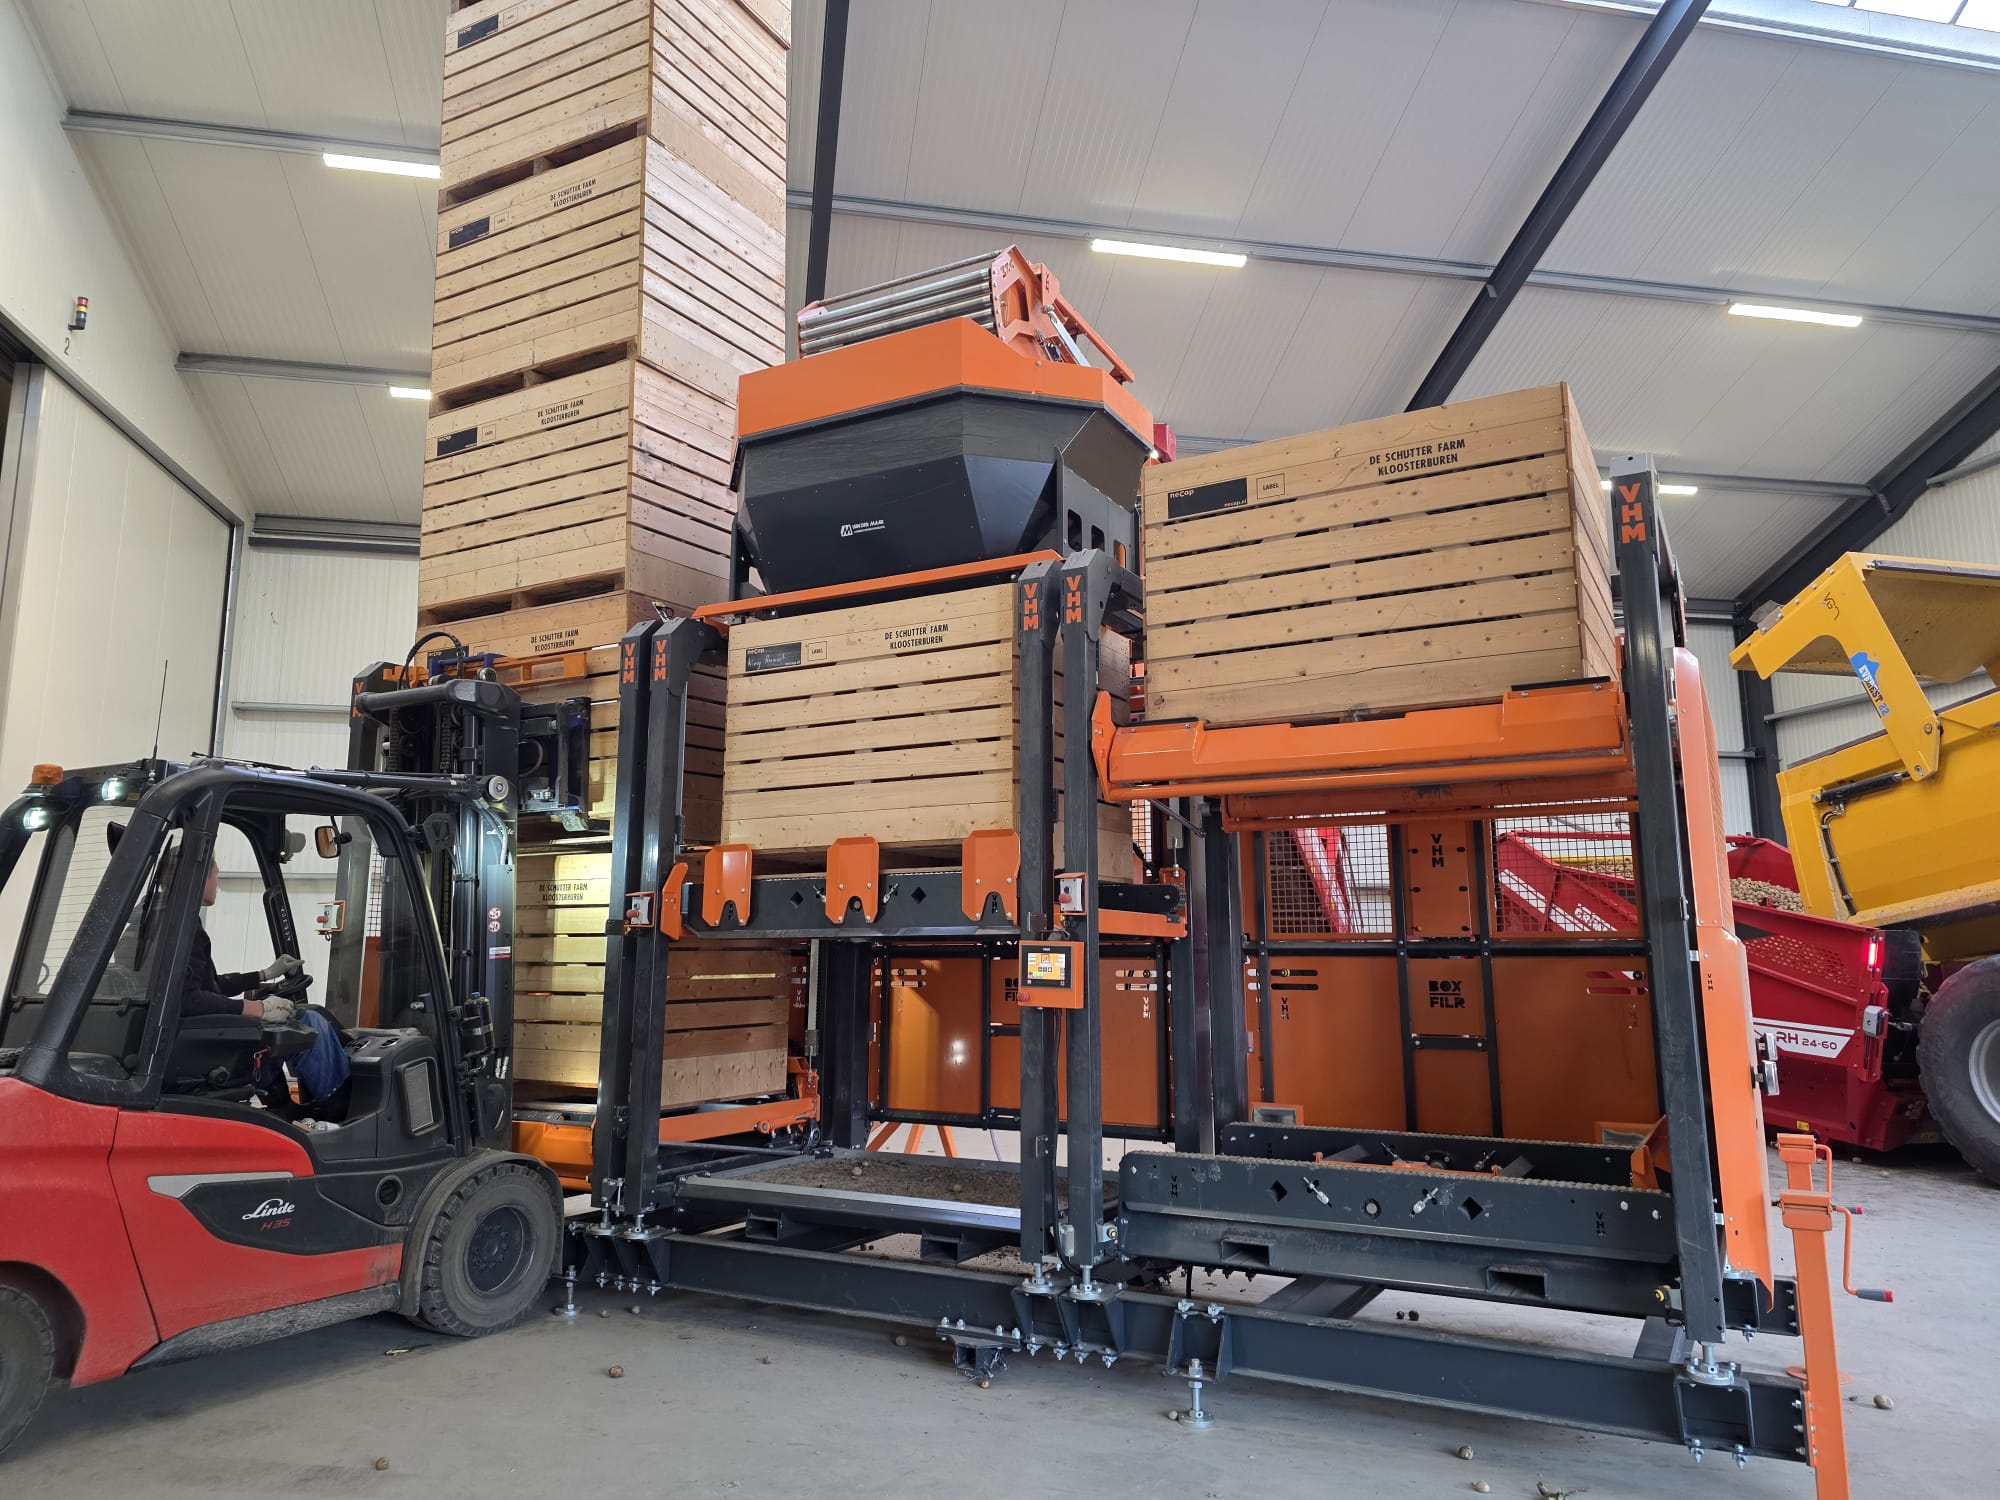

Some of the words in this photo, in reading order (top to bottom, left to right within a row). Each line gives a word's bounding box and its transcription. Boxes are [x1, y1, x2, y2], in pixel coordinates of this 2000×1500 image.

[1369, 454, 1382, 466] DE
[1385, 445, 1433, 462] SCHUTTER
[1438, 438, 1466, 453] FARM
[1378, 453, 1458, 476] KLOOSTERBUREN
[1262, 482, 1280, 491] LABEL
[1618, 482, 1647, 544] VHM
[1024, 582, 1038, 631] VHM
[1066, 575, 1082, 624] VHM
[530, 636, 537, 644] DE
[539, 631, 563, 642] SCHUTTER
[564, 629, 578, 638] FARM
[884, 632, 892, 640] DE
[896, 626, 927, 638] SCHUTTER
[930, 624, 949, 634] FARM
[890, 636, 944, 650] KLOOSTERBUREN
[623, 642, 636, 684] VHM
[654, 640, 666, 681] VHM
[1431, 833, 1444, 868] VHM
[1428, 980, 1462, 992] BOX
[1802, 1038, 1838, 1050] 24-60
[242, 1198, 296, 1220] Linde
